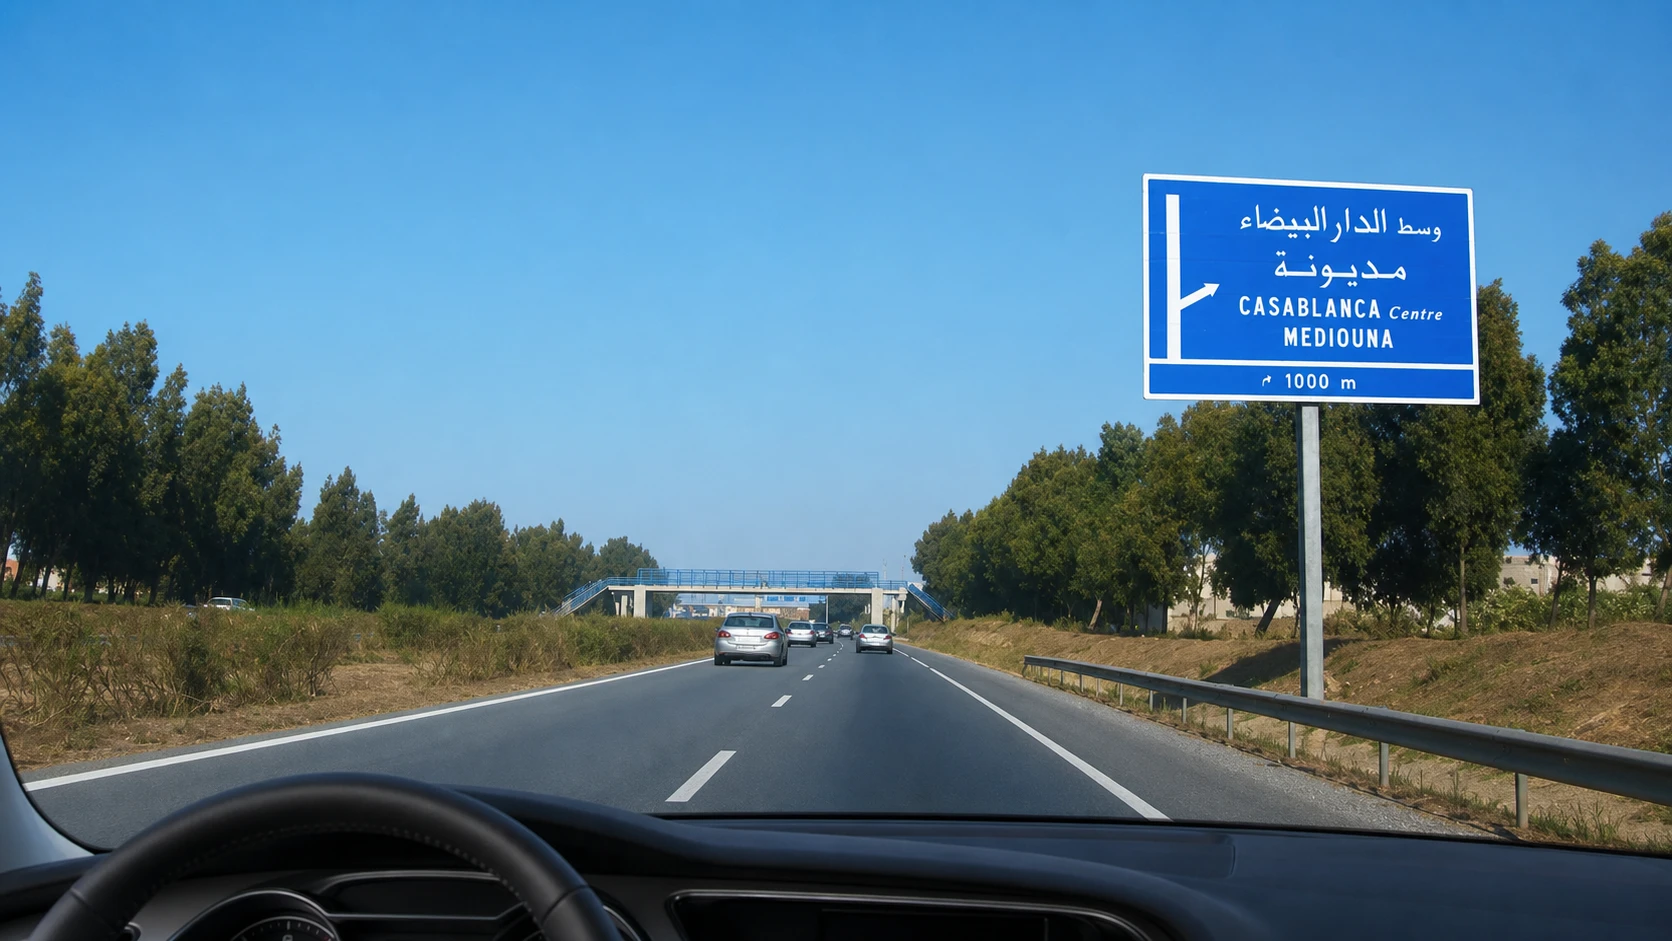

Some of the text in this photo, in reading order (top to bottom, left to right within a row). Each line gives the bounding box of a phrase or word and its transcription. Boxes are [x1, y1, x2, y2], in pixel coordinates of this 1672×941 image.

[1240, 204, 1442, 243] وسط الدار البيضاء
[1274, 250, 1407, 289] مديونة
[1239, 295, 1443, 321] CASABLANCA Centre
[1284, 326, 1394, 349] MEDIOUNA
[1285, 373, 1356, 390] 1000 m
